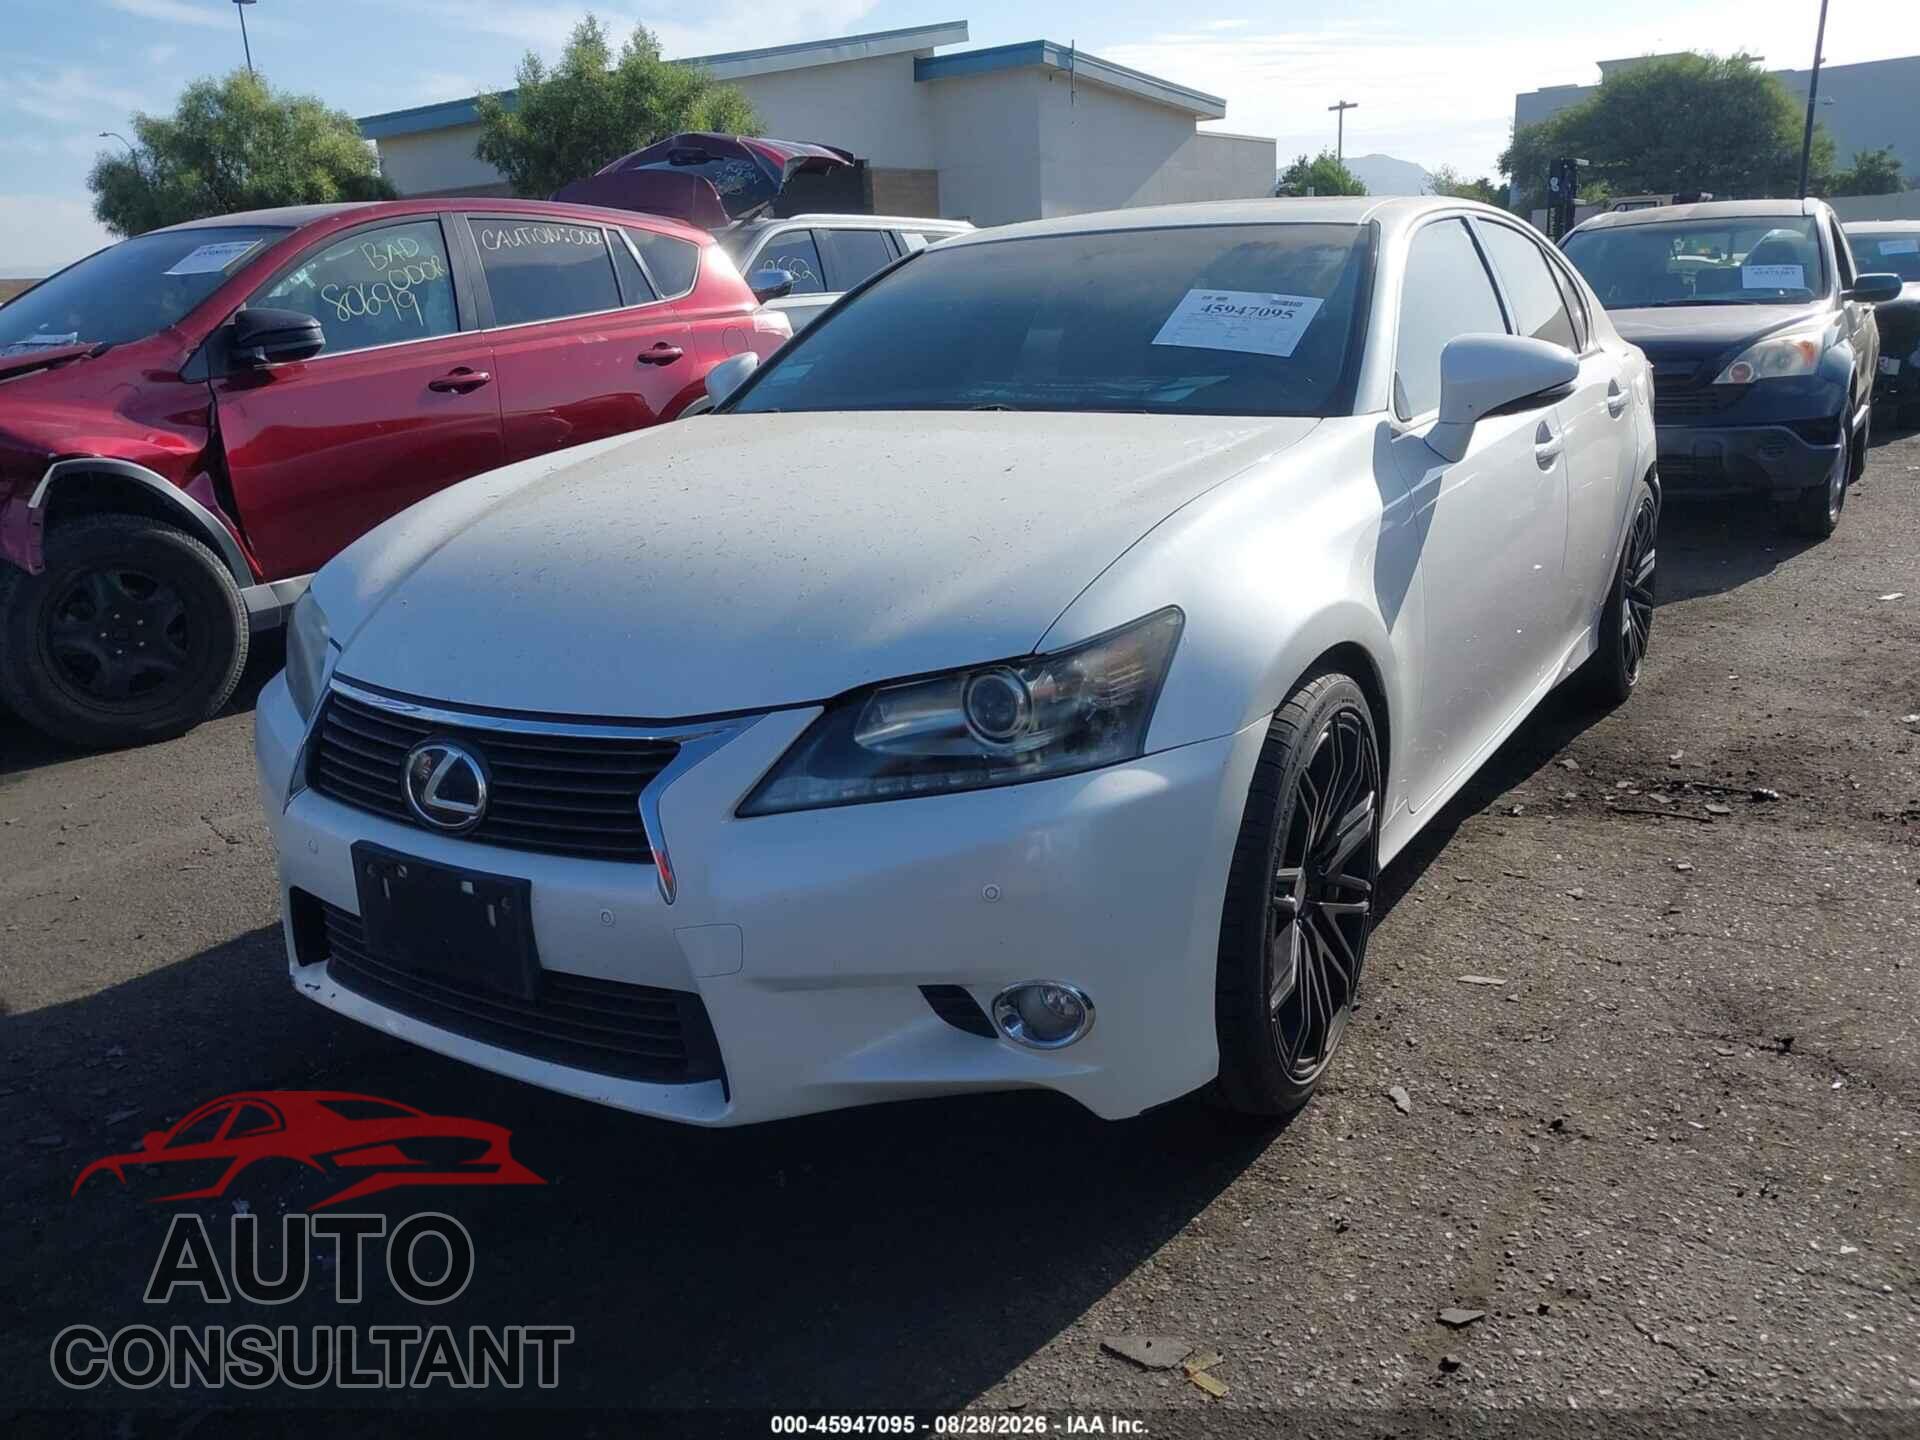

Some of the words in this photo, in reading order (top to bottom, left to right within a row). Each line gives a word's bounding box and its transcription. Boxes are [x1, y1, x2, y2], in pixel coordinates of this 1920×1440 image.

[360, 237, 421, 272] BAD
[388, 255, 447, 291] ODOR
[321, 282, 424, 326] 80699
[1200, 303, 1295, 319] 45947095
